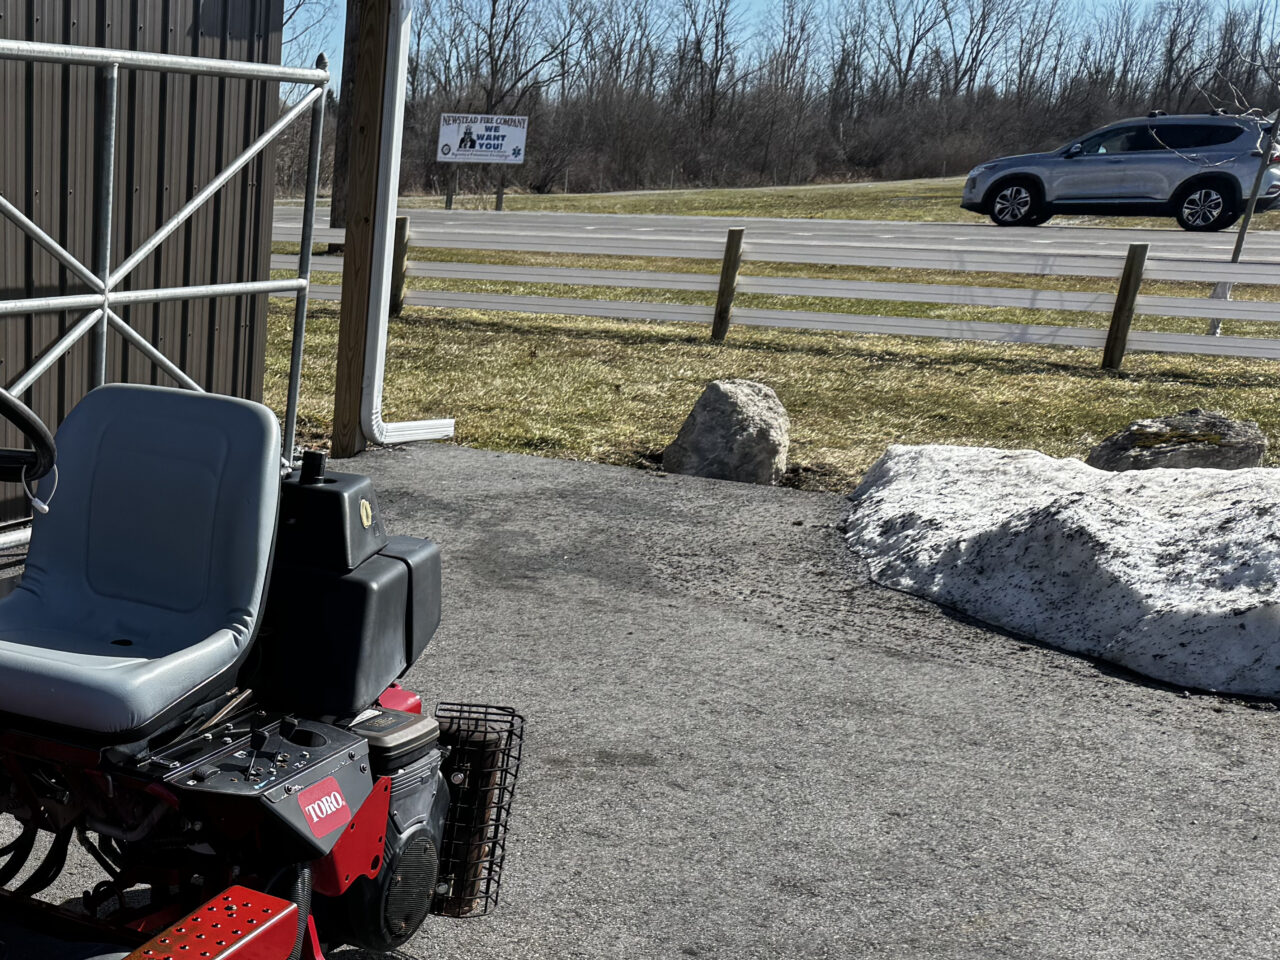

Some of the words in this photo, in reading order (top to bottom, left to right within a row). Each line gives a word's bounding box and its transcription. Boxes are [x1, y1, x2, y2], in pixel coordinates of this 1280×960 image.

[442, 115, 478, 126] NEWSTEAD
[479, 116, 494, 124] FIRE
[495, 117, 527, 129] COMPANY
[476, 133, 507, 141] WANT
[478, 142, 503, 150] YOU!
[305, 791, 343, 822] TORO
